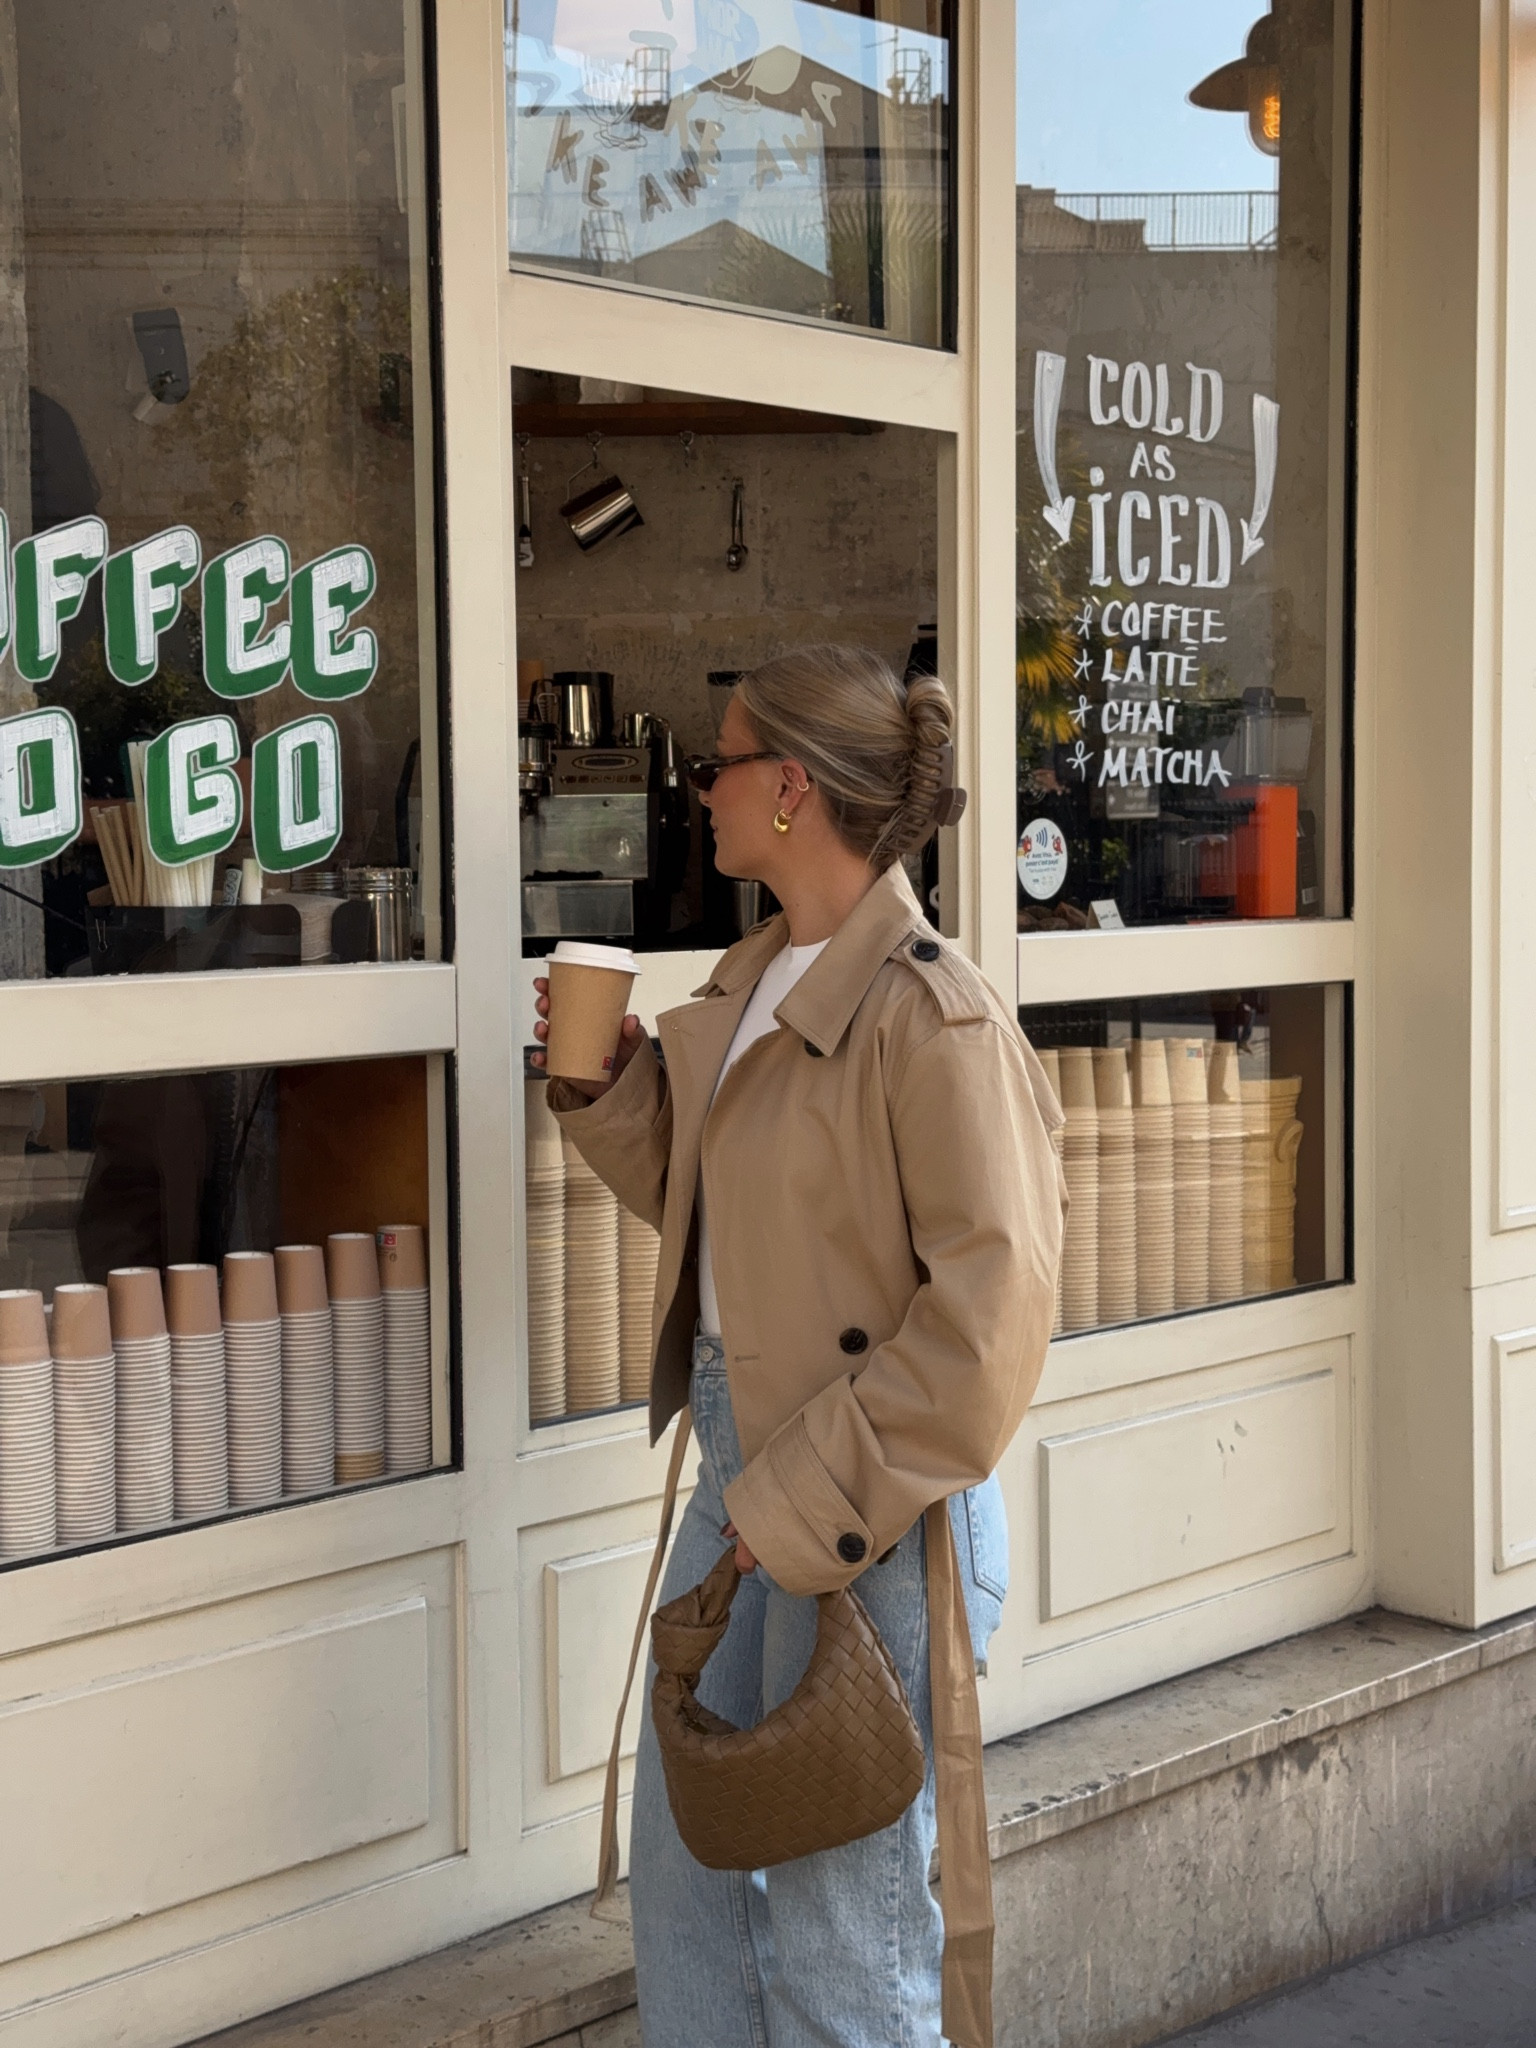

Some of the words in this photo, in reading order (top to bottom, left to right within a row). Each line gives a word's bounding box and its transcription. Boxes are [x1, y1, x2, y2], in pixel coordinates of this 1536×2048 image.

[1087, 354, 1223, 442] COLD
[1130, 442, 1175, 481] AS
[0, 508, 377, 700] FFEE
[1101, 600, 1227, 643] COFFEE
[145, 714, 342, 873] GO
[1098, 747, 1232, 787] MATCHA
